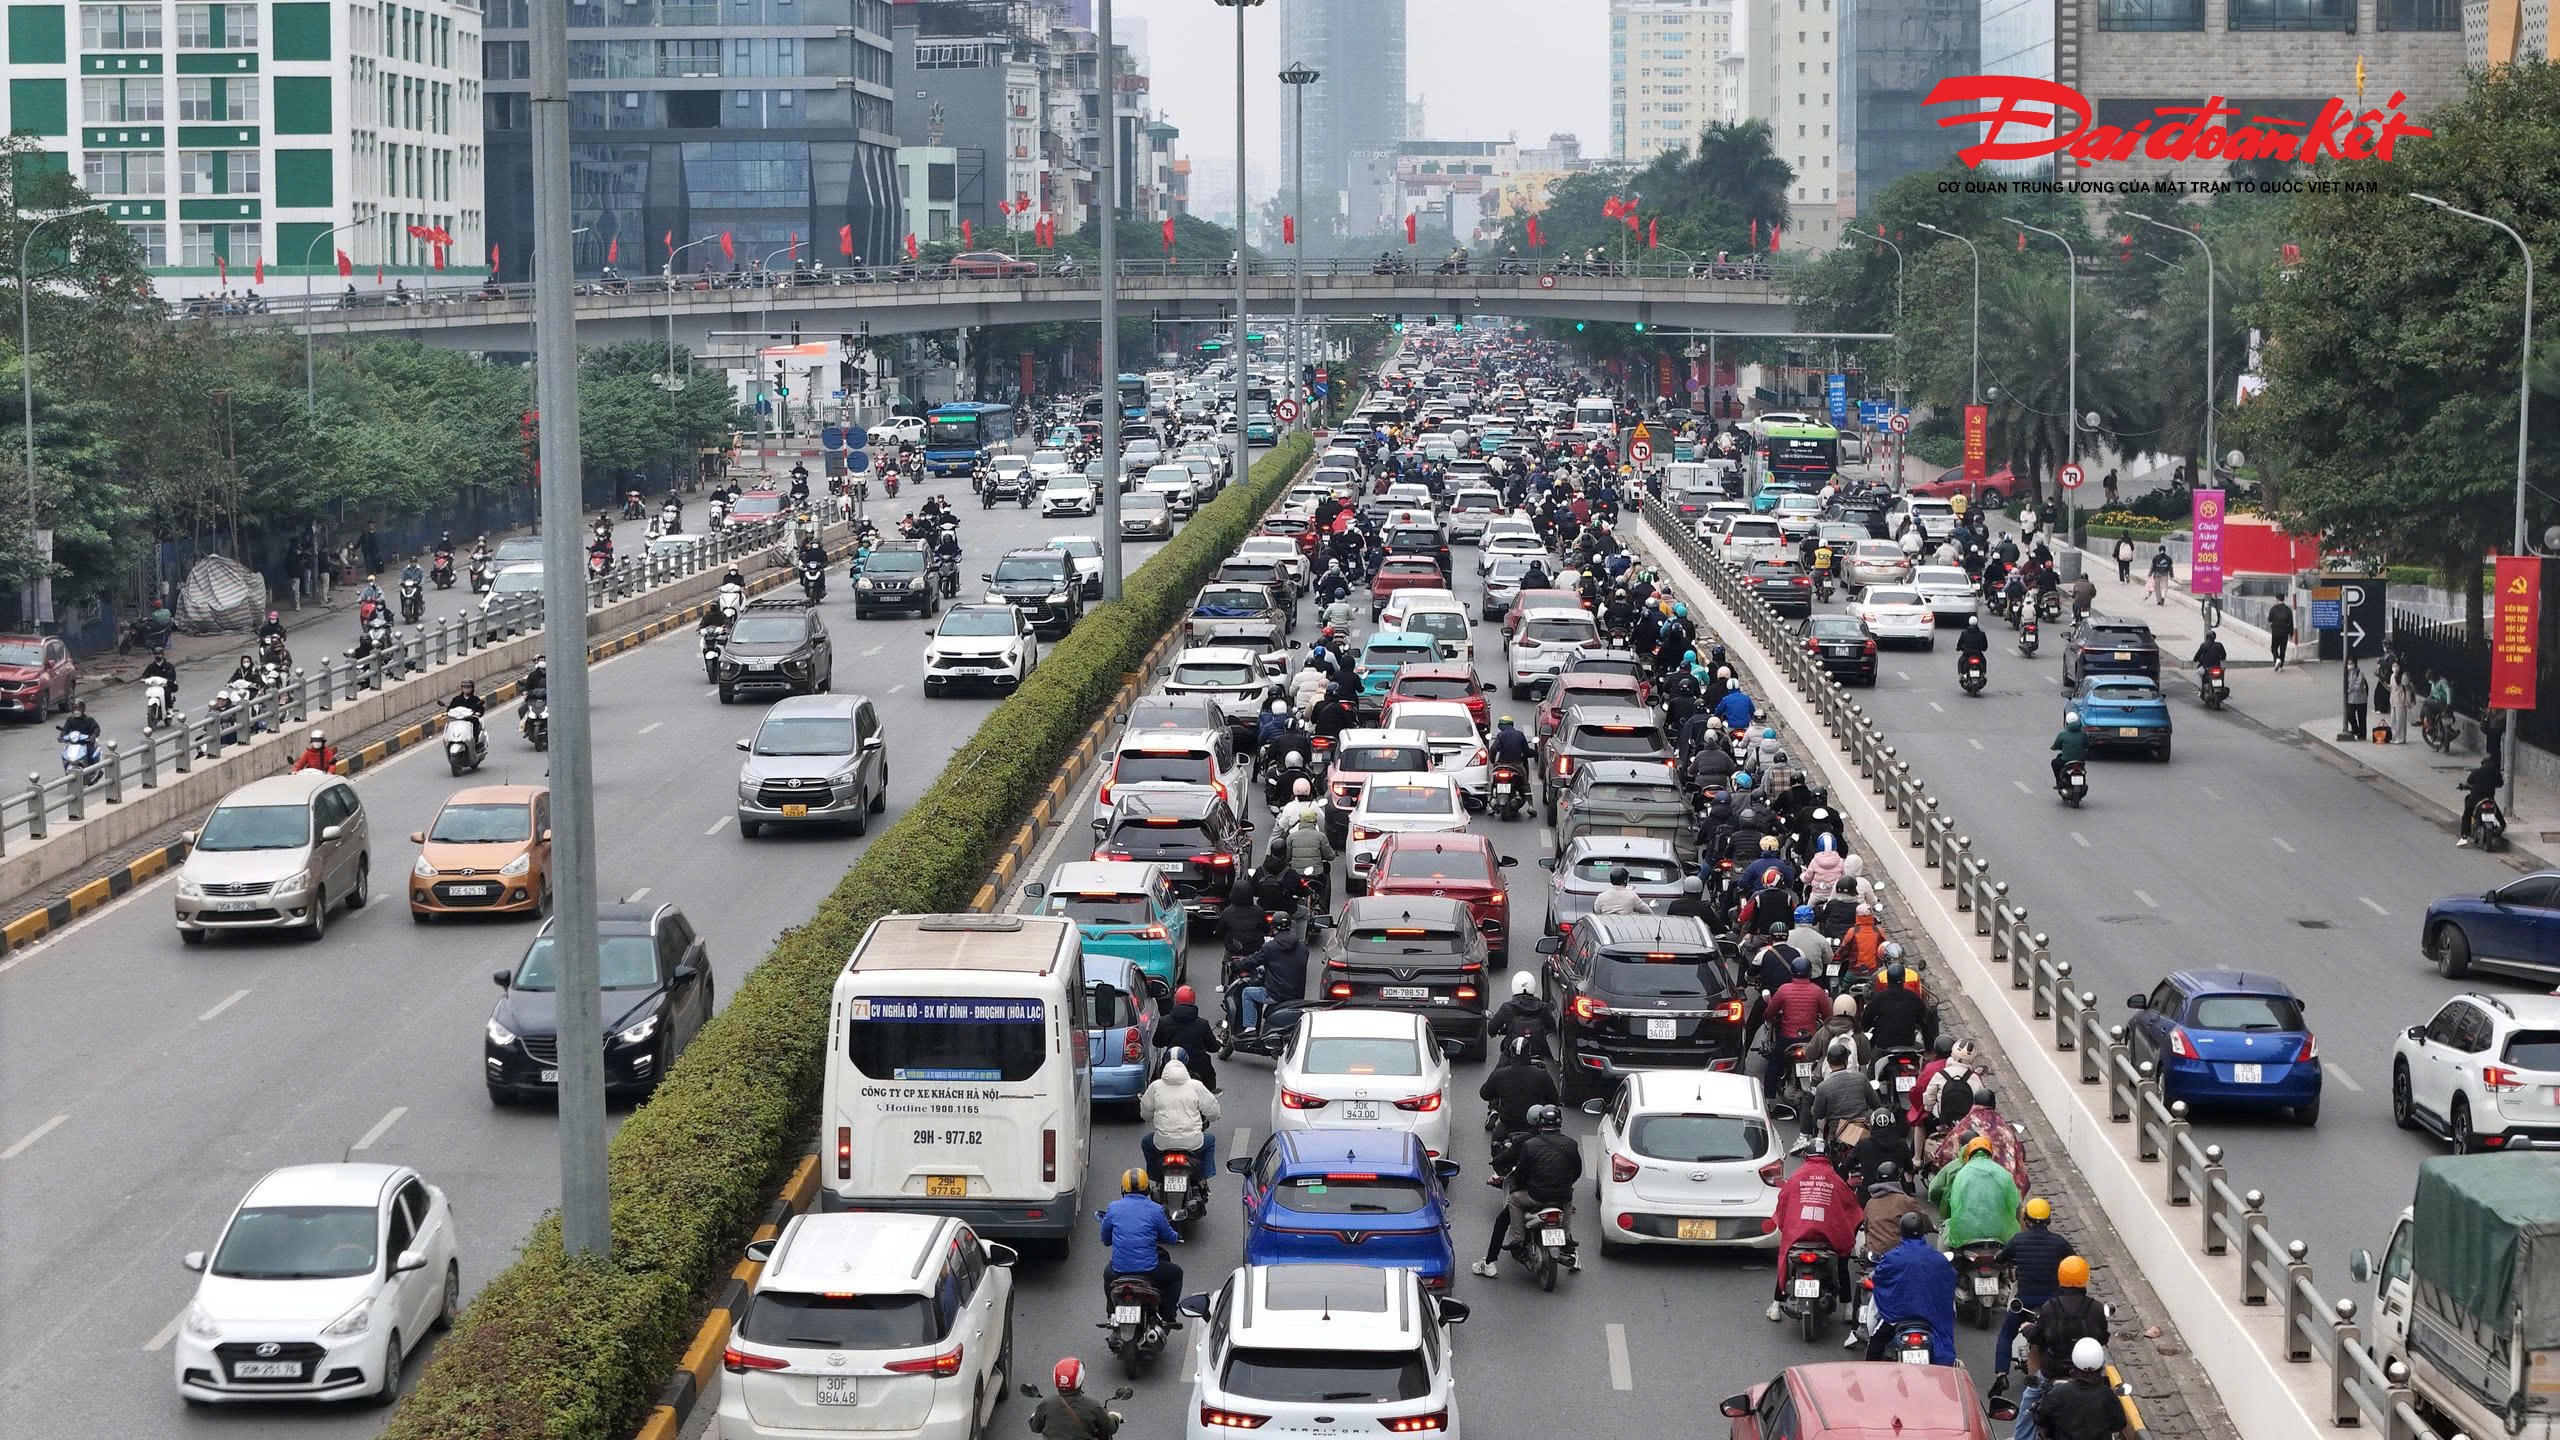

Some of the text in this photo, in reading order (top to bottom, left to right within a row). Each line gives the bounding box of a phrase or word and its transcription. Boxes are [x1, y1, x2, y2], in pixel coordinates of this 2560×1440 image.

[854, 1002, 870, 1017] 71
[871, 1004, 882, 1018] CV
[883, 1002, 905, 1019] NGHĨA
[924, 1005, 936, 1018] BX
[861, 1086, 1000, 1102] CÔNG TY CP XE KHÁCH HÀ NỘI
[886, 1104, 980, 1114] Hotline 1900.1165
[1353, 1102, 1369, 1110] 30K
[1346, 1110, 1376, 1118] 943.00
[913, 1130, 934, 1145] 29H
[945, 1130, 983, 1146] 977.62
[938, 1177, 956, 1186] 29H
[930, 1186, 962, 1196] 977.62
[826, 1378, 848, 1390] 30F
[818, 1392, 856, 1404] 984.48
